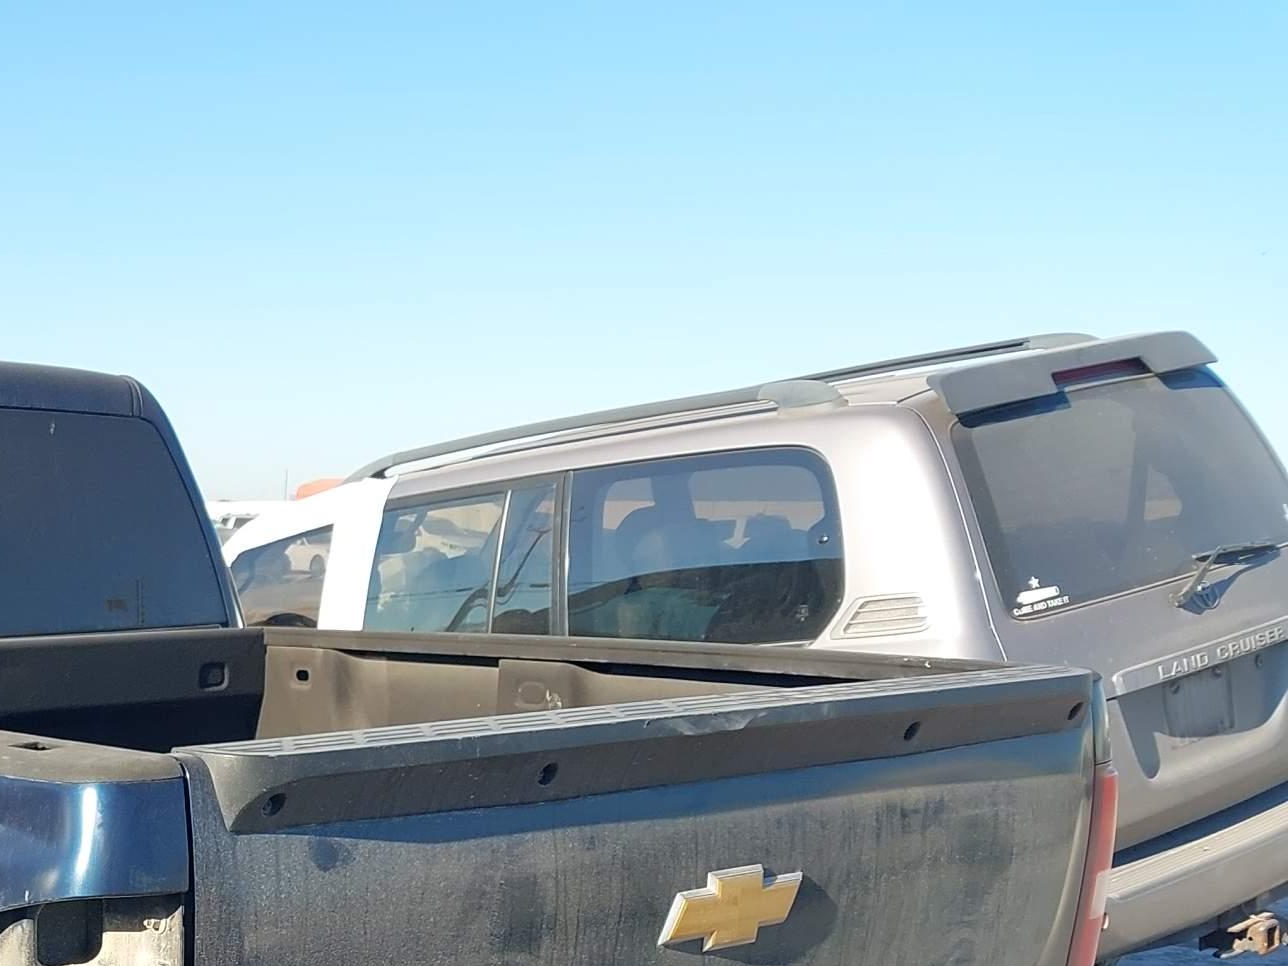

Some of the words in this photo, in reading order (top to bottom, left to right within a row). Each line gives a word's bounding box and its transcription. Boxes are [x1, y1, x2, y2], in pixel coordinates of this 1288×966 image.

[1033, 601, 1047, 611] AND
[1047, 597, 1063, 608] TAKE
[1158, 651, 1209, 680] LAND
[1216, 625, 1286, 660] CRUISER
